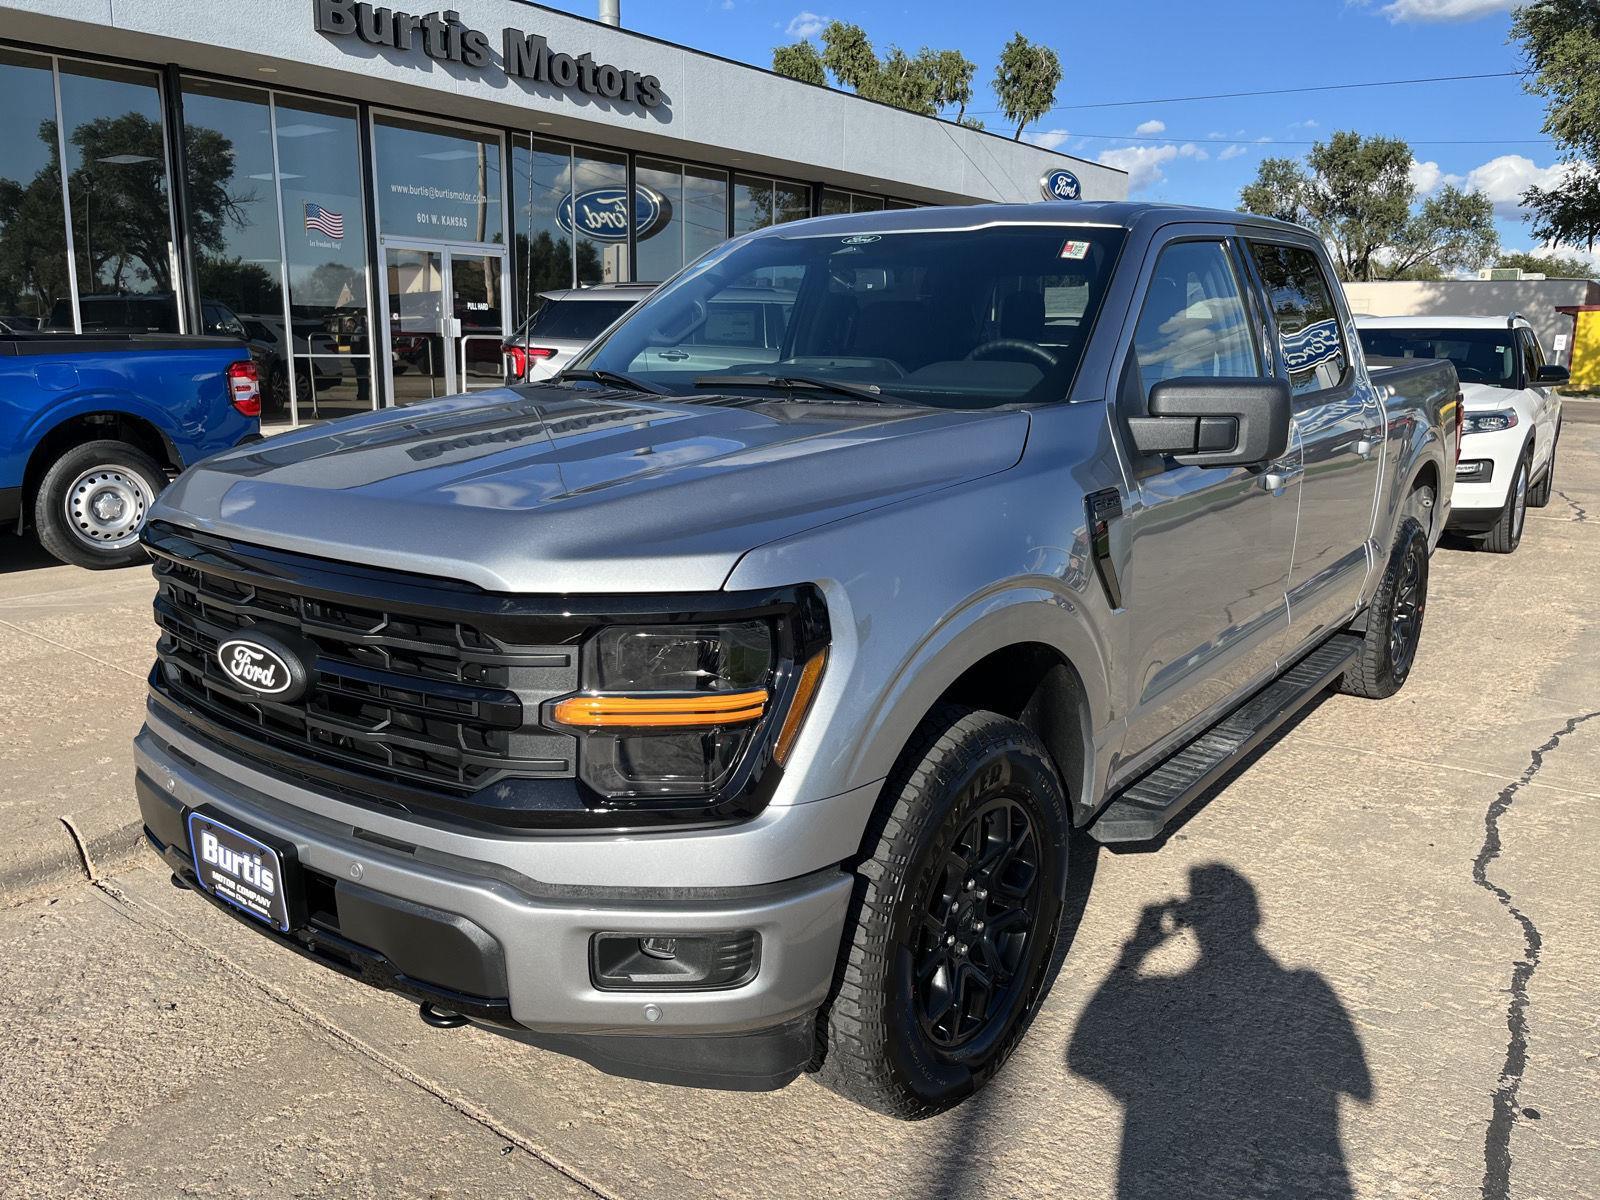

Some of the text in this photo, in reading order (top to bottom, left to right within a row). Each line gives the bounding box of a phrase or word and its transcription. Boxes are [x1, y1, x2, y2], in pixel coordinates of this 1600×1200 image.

[314, 0, 662, 107] Burtis Motors
[1054, 175, 1077, 198] Ford
[416, 212, 468, 228] 601 W. KANSAS
[467, 302, 489, 311] PULL HARD
[230, 645, 276, 687] Ford
[201, 830, 275, 895] Burtis
[212, 870, 272, 908] MOTOR COMPANY
